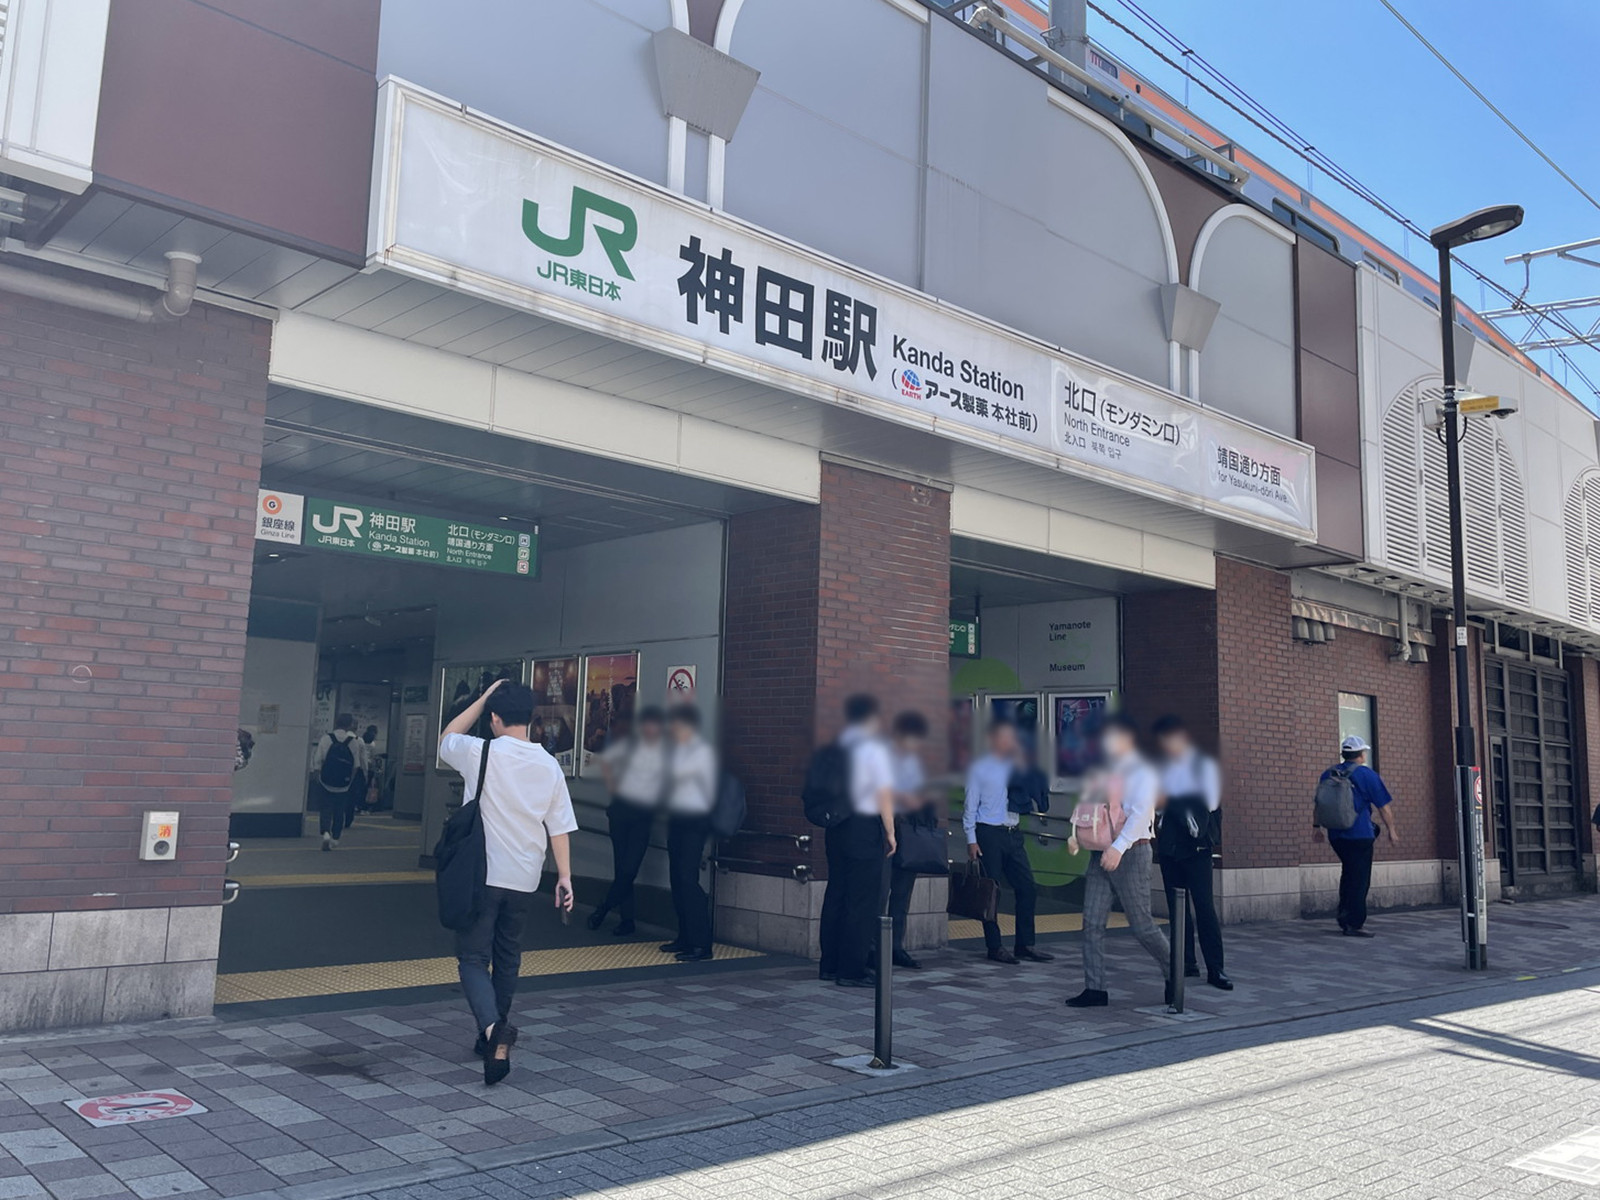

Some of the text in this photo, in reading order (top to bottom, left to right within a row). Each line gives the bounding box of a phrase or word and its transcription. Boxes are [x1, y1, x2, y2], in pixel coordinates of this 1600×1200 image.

[522, 185, 638, 281] JR
[537, 260, 621, 301] JR東日本
[677, 235, 877, 382] 神田駅
[893, 334, 1024, 401] Kanda Station
[901, 388, 922, 400] EARTH
[1064, 412, 1130, 447] North Entrance
[1064, 431, 1087, 449] 北入口
[1217, 445, 1281, 486] 靖国通り方面
[261, 516, 295, 532] 銀座線
[312, 505, 364, 539] JR
[369, 511, 416, 534] 神田駅
[260, 528, 295, 539] Ginza Line
[368, 530, 430, 547] Kanda Station
[446, 547, 492, 560] North Entrance
[1049, 621, 1092, 631] Yamanote
[1049, 632, 1067, 641] Line
[1049, 663, 1086, 672] Museum
